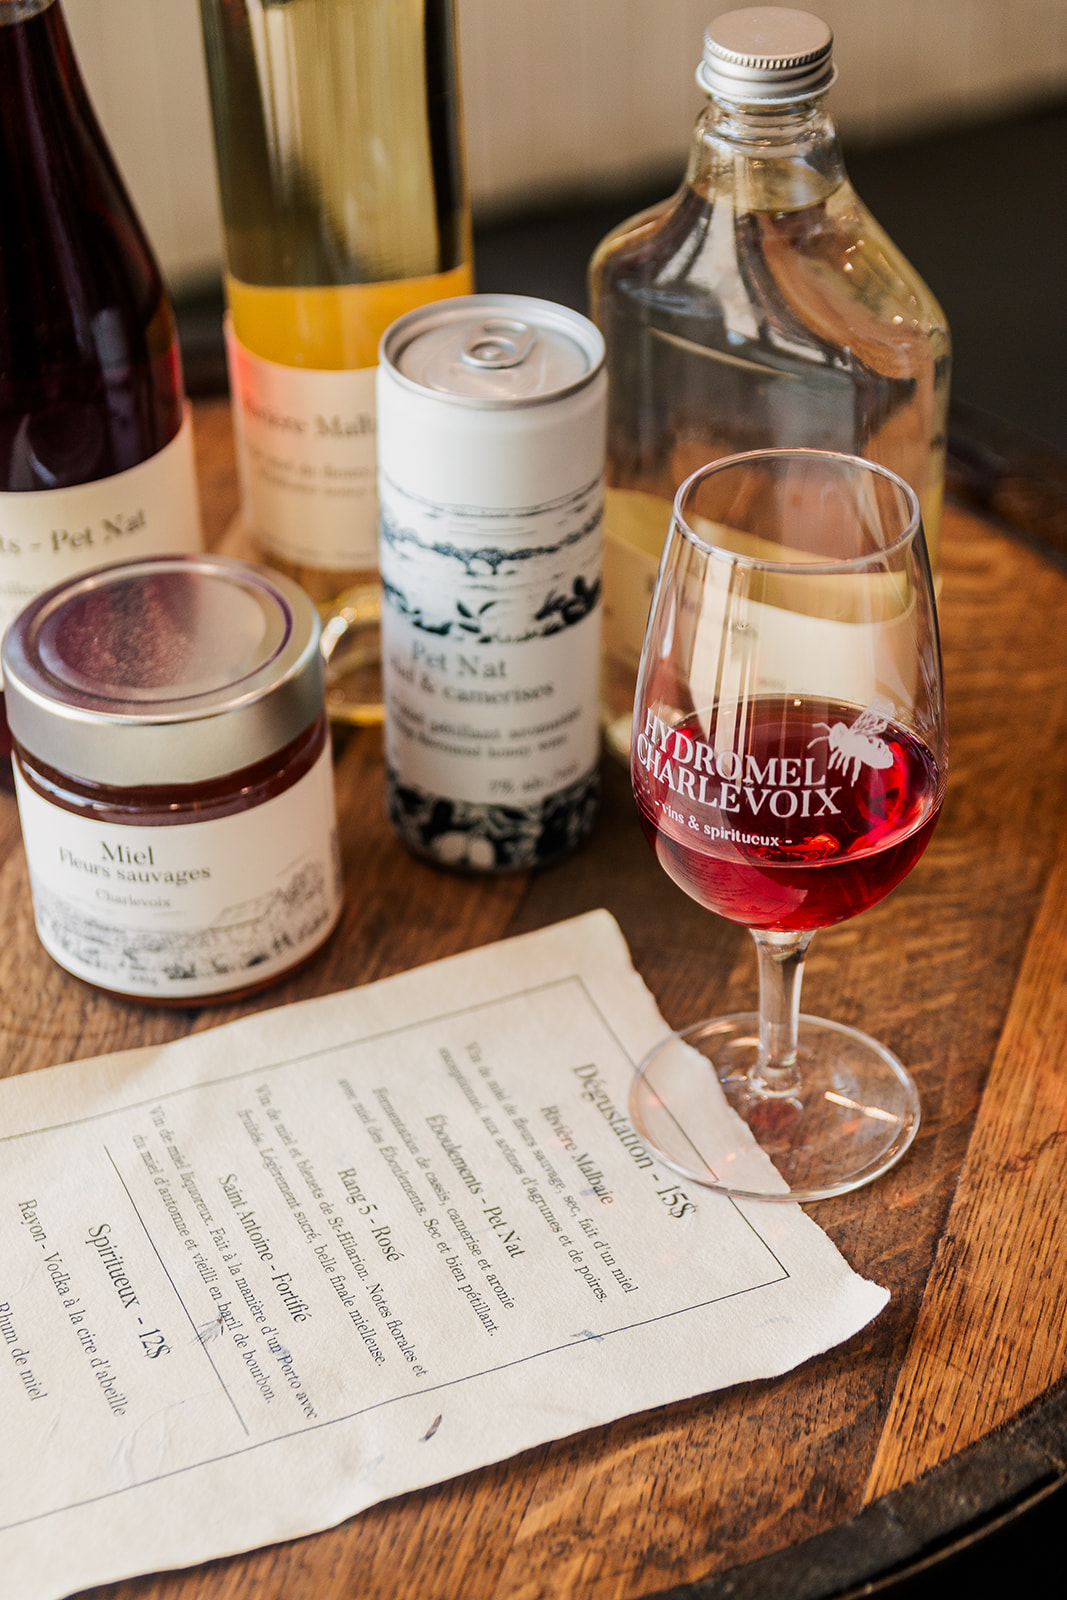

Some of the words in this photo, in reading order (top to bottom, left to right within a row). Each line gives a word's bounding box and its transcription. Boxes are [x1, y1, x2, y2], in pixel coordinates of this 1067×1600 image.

[51, 528, 93, 552] Pet
[101, 509, 146, 542] Nat
[412, 641, 447, 673] Pet
[457, 654, 507, 679] Nat
[645, 707, 826, 786] HYDROMEL
[637, 733, 842, 818] CHARLEVOIX
[661, 804, 684, 824] vins
[688, 815, 699, 830] &
[59, 847, 110, 878] Fleurs
[116, 867, 211, 886] sauvages
[102, 841, 154, 866] Miel
[95, 888, 171, 908] Charlevoix
[149, 1105, 165, 1128] Vin
[159, 1129, 175, 1143] de
[166, 1145, 191, 1170] miel
[495, 1138, 526, 1175] arômes
[540, 1105, 577, 1151] Rivière
[571, 1153, 613, 1204] Malbaie
[573, 1063, 655, 1170] Dégustation
[656, 1186, 697, 1218] 15$
[180, 1171, 214, 1226] liquoreux.
[372, 1087, 420, 1155] Fermentation
[415, 1156, 431, 1169] de
[425, 1172, 450, 1206] cassis,
[447, 1208, 482, 1256] camerise
[477, 1259, 493, 1271] et
[486, 1274, 515, 1309] aronie
[425, 1114, 484, 1195] Éboulements
[483, 1206, 507, 1230] Pet
[498, 1230, 525, 1258] Nat
[478, 1066, 491, 1078] de
[487, 1080, 511, 1102] miel
[502, 1104, 517, 1116] de
[512, 1117, 537, 1147] fleurs
[532, 1150, 566, 1194] sauvage,
[563, 1195, 581, 1217] sec,
[578, 1218, 599, 1238] fait
[593, 1241, 616, 1267] d'un
[611, 1268, 639, 1294] miel
[18, 1199, 47, 1242] Rayon
[337, 1167, 367, 1205] Rang
[359, 1204, 378, 1215] 5
[371, 1226, 405, 1262] Rosé
[352, 1102, 376, 1125] miel
[367, 1126, 384, 1144] des
[378, 1145, 427, 1217] Éboulements.
[423, 1218, 441, 1239] Sec
[436, 1242, 452, 1254] et
[445, 1255, 466, 1282] bien
[457, 1284, 499, 1336] pétillant.
[521, 1177, 563, 1233] d'agrumes
[209, 1227, 230, 1251] Fait
[218, 1174, 248, 1209] Saint
[236, 1211, 273, 1261] Antoine
[271, 1272, 312, 1323] Fortifié
[255, 1083, 272, 1107] Vin
[266, 1108, 281, 1121] de
[274, 1123, 298, 1146] miel
[288, 1148, 303, 1159] et
[296, 1159, 325, 1200] bleuets
[318, 1201, 335, 1215] de
[327, 1217, 369, 1282] St-Hilarion.
[365, 1283, 392, 1318] Notes
[386, 1320, 417, 1362] florales
[412, 1365, 428, 1377] et
[558, 1235, 575, 1247] et
[44, 1251, 71, 1296] Vodka
[132, 1135, 148, 1150] du
[140, 1150, 164, 1175] miel
[153, 1177, 190, 1237] d'automne
[184, 1239, 199, 1251] et
[192, 1252, 218, 1284] vieilli
[209, 1286, 223, 1301] en
[217, 1301, 243, 1331] baril
[233, 1333, 249, 1348] de
[242, 1349, 275, 1404] bourbon.
[222, 1253, 237, 1262] à
[227, 1262, 243, 1276] la
[259, 1147, 302, 1210] Légèrement
[293, 1211, 322, 1244] sucré,
[314, 1244, 337, 1274] belle
[329, 1275, 356, 1307] finale
[348, 1309, 386, 1367] mielleuse.
[568, 1249, 584, 1263] de
[63, 1298, 80, 1308] à
[85, 1224, 140, 1309] Spiritueux
[139, 1329, 171, 1359] 12$
[235, 1277, 266, 1323] manière
[574, 1265, 607, 1303] poires.
[0, 1302, 18, 1344] Rhum
[69, 1309, 86, 1325] la
[11, 1348, 30, 1367] de
[77, 1328, 97, 1353] cire
[261, 1326, 282, 1354] d'un
[19, 1369, 48, 1402] miel
[90, 1358, 128, 1415] d'abeille
[276, 1351, 301, 1389] Porto
[295, 1392, 317, 1418] avec
